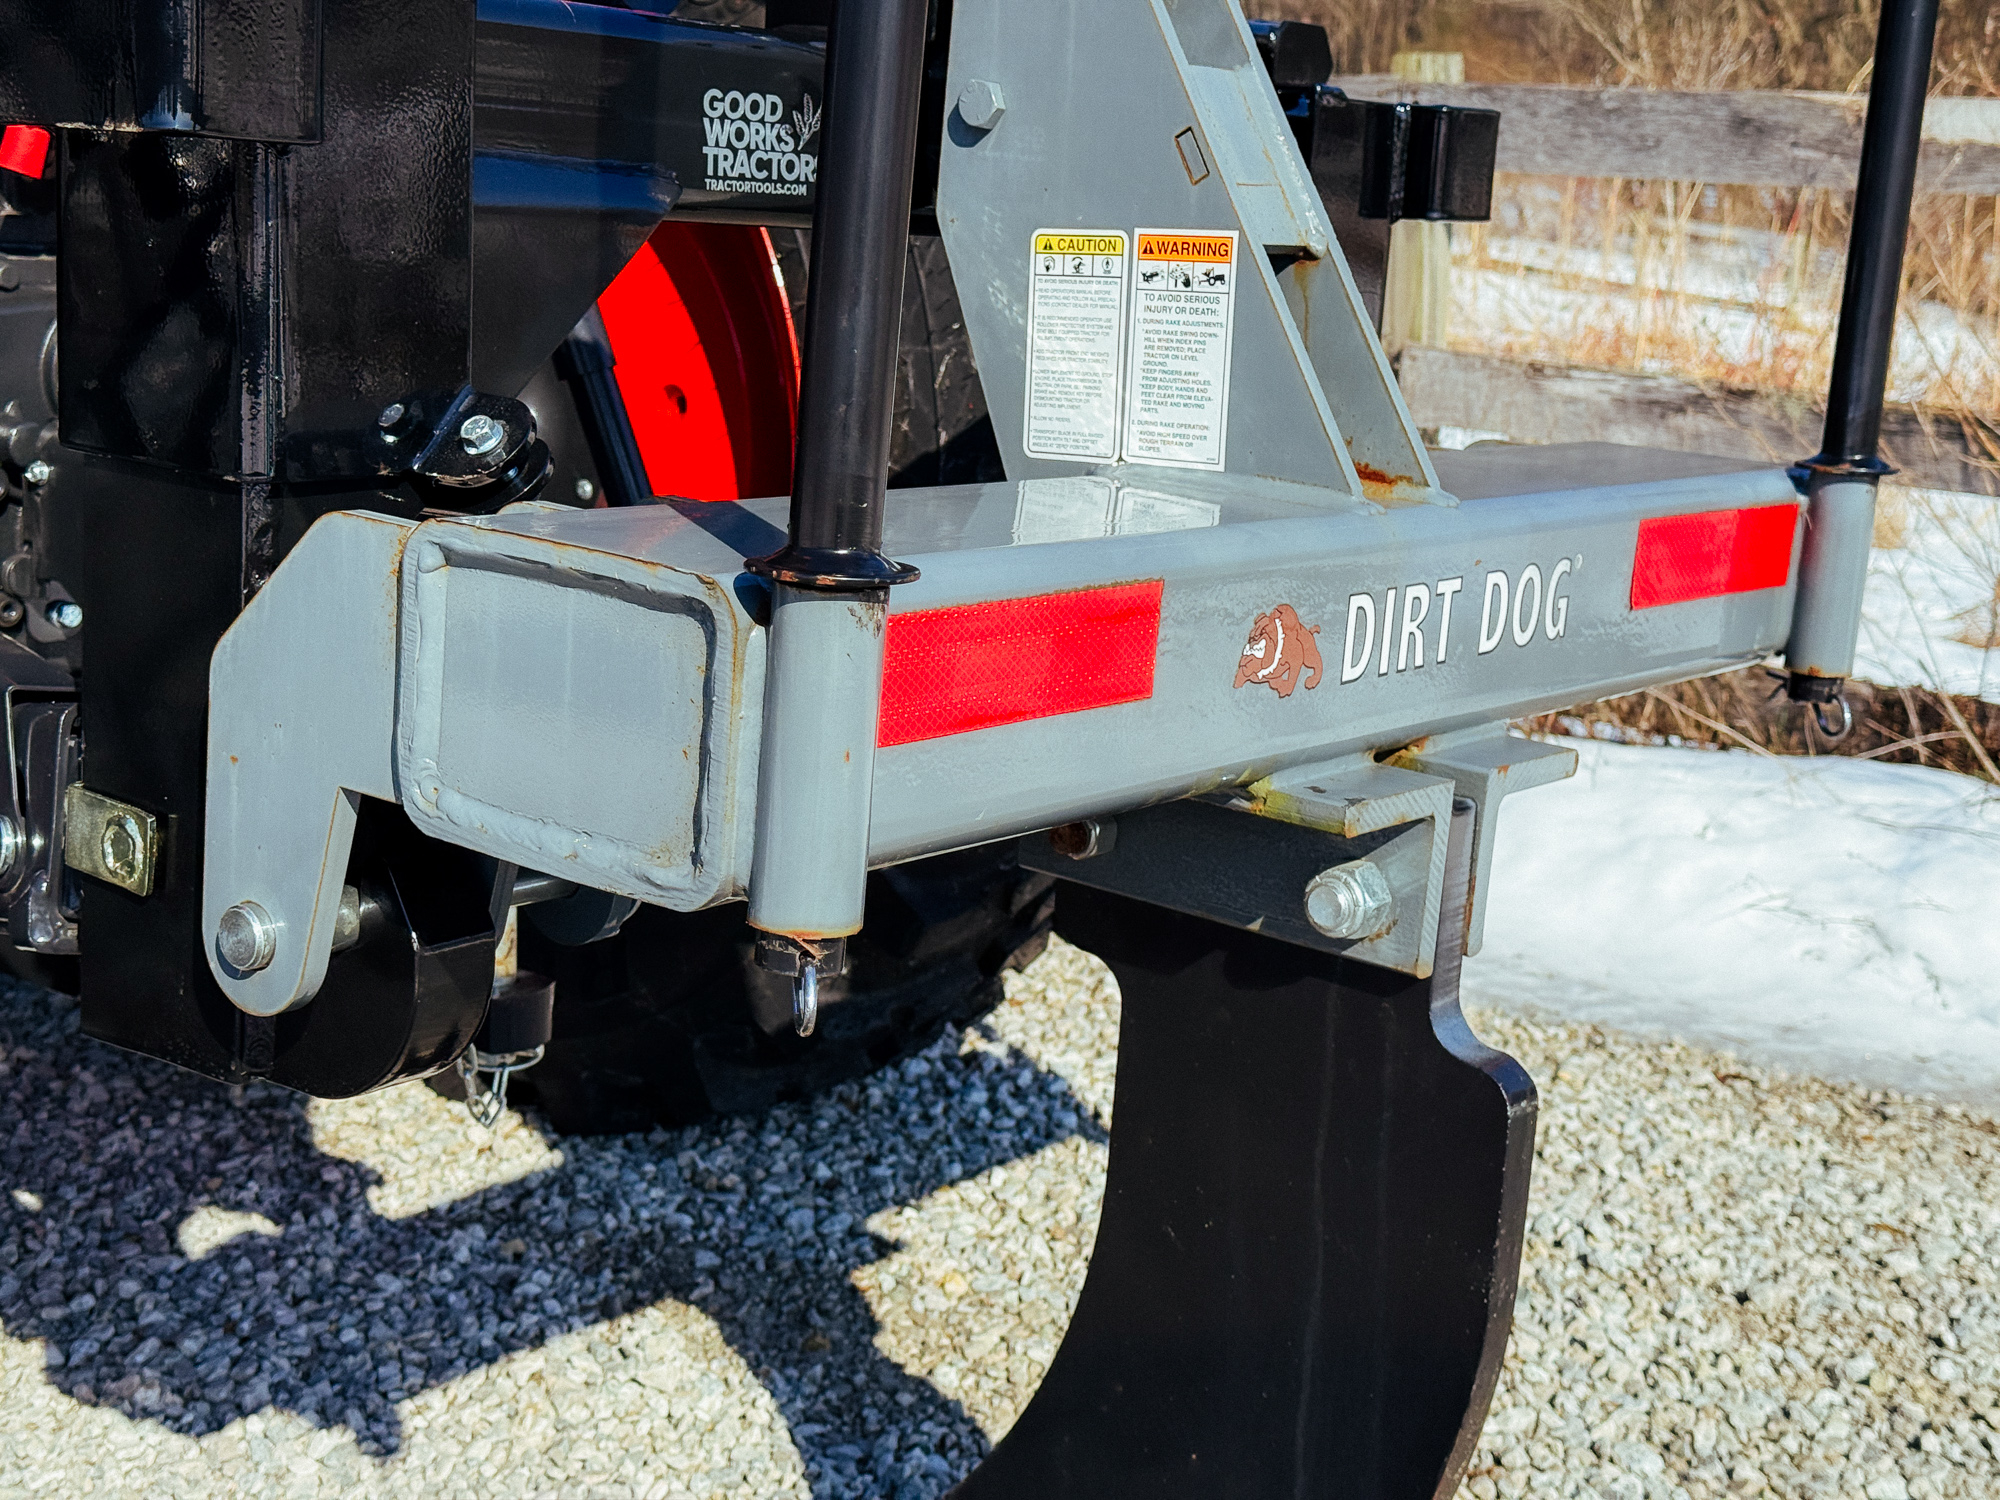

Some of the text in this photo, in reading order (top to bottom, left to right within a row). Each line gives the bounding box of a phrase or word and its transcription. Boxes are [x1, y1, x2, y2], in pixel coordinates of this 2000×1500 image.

[704, 88, 783, 122] GOOD
[703, 117, 794, 152] WORKS
[702, 146, 818, 182] TRACTOR
[705, 179, 807, 196] TRACTORTOOLS.COM
[1058, 238, 1116, 252] CAUTION
[1157, 240, 1229, 257] WARNING
[1144, 293, 1220, 304] TO AVOID SERIOUS
[1144, 305, 1219, 316] INJURY OR DEATH:
[1340, 557, 1572, 685] DIRT DOG
